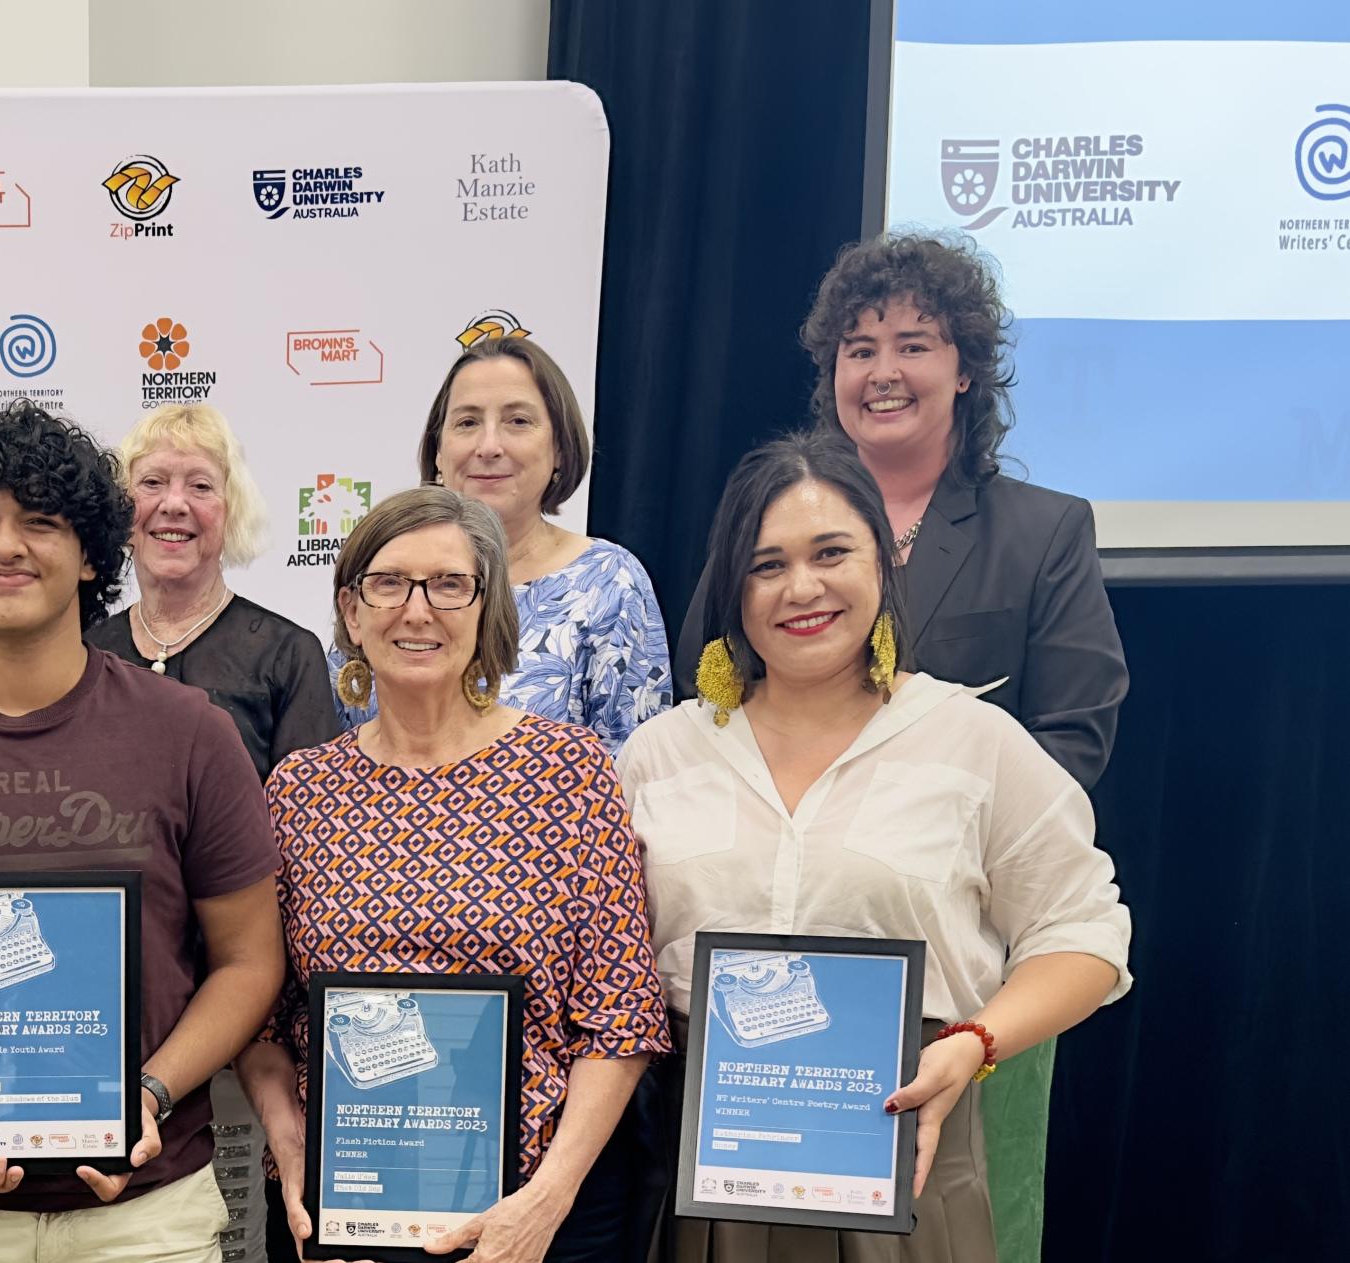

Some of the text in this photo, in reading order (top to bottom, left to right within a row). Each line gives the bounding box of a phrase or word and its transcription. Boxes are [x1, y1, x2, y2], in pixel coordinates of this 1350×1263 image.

[1012, 134, 1143, 159] CHARLES
[470, 153, 522, 174] Kath
[1012, 158, 1124, 182] DARWIN
[293, 167, 362, 181] CHARLES
[293, 180, 353, 192] DARWIN
[456, 176, 535, 198] Manzie
[1012, 180, 1181, 204] UNIVERSITY
[293, 191, 384, 205] UNIVERSITY
[293, 206, 358, 219] AUSTRALIA
[462, 202, 528, 222] Estate
[1012, 207, 1133, 229] AUSTRALIA
[110, 222, 173, 239] ZipPrint
[1280, 220, 1329, 230] NORTHERN
[1279, 235, 1332, 250] Writers'
[294, 337, 354, 350] BROWN'S
[321, 348, 359, 362] MART
[142, 372, 216, 386] NORTHERN
[142, 386, 210, 399] TERRITORY
[26, 1010, 100, 1022] TERRITORY
[22, 1024, 71, 1035] AWARDS
[74, 1024, 108, 1037] 2023
[10, 1046, 35, 1054] Youth
[38, 1046, 64, 1054] Award
[719, 1062, 874, 1081] NORTHERN TERRITORY
[718, 1074, 882, 1096] LITERARY AWARDS 2023
[730, 1095, 770, 1104] Writers'
[772, 1098, 805, 1107] Centre
[808, 1100, 839, 1110] Poetry
[842, 1102, 870, 1111] Award
[337, 1105, 480, 1117] NORTHERN TERRITORY
[715, 1108, 750, 1117] WINNER
[336, 1117, 488, 1132] LITERARY AWARDS 2023
[336, 1137, 425, 1147] Flash Fiction Award
